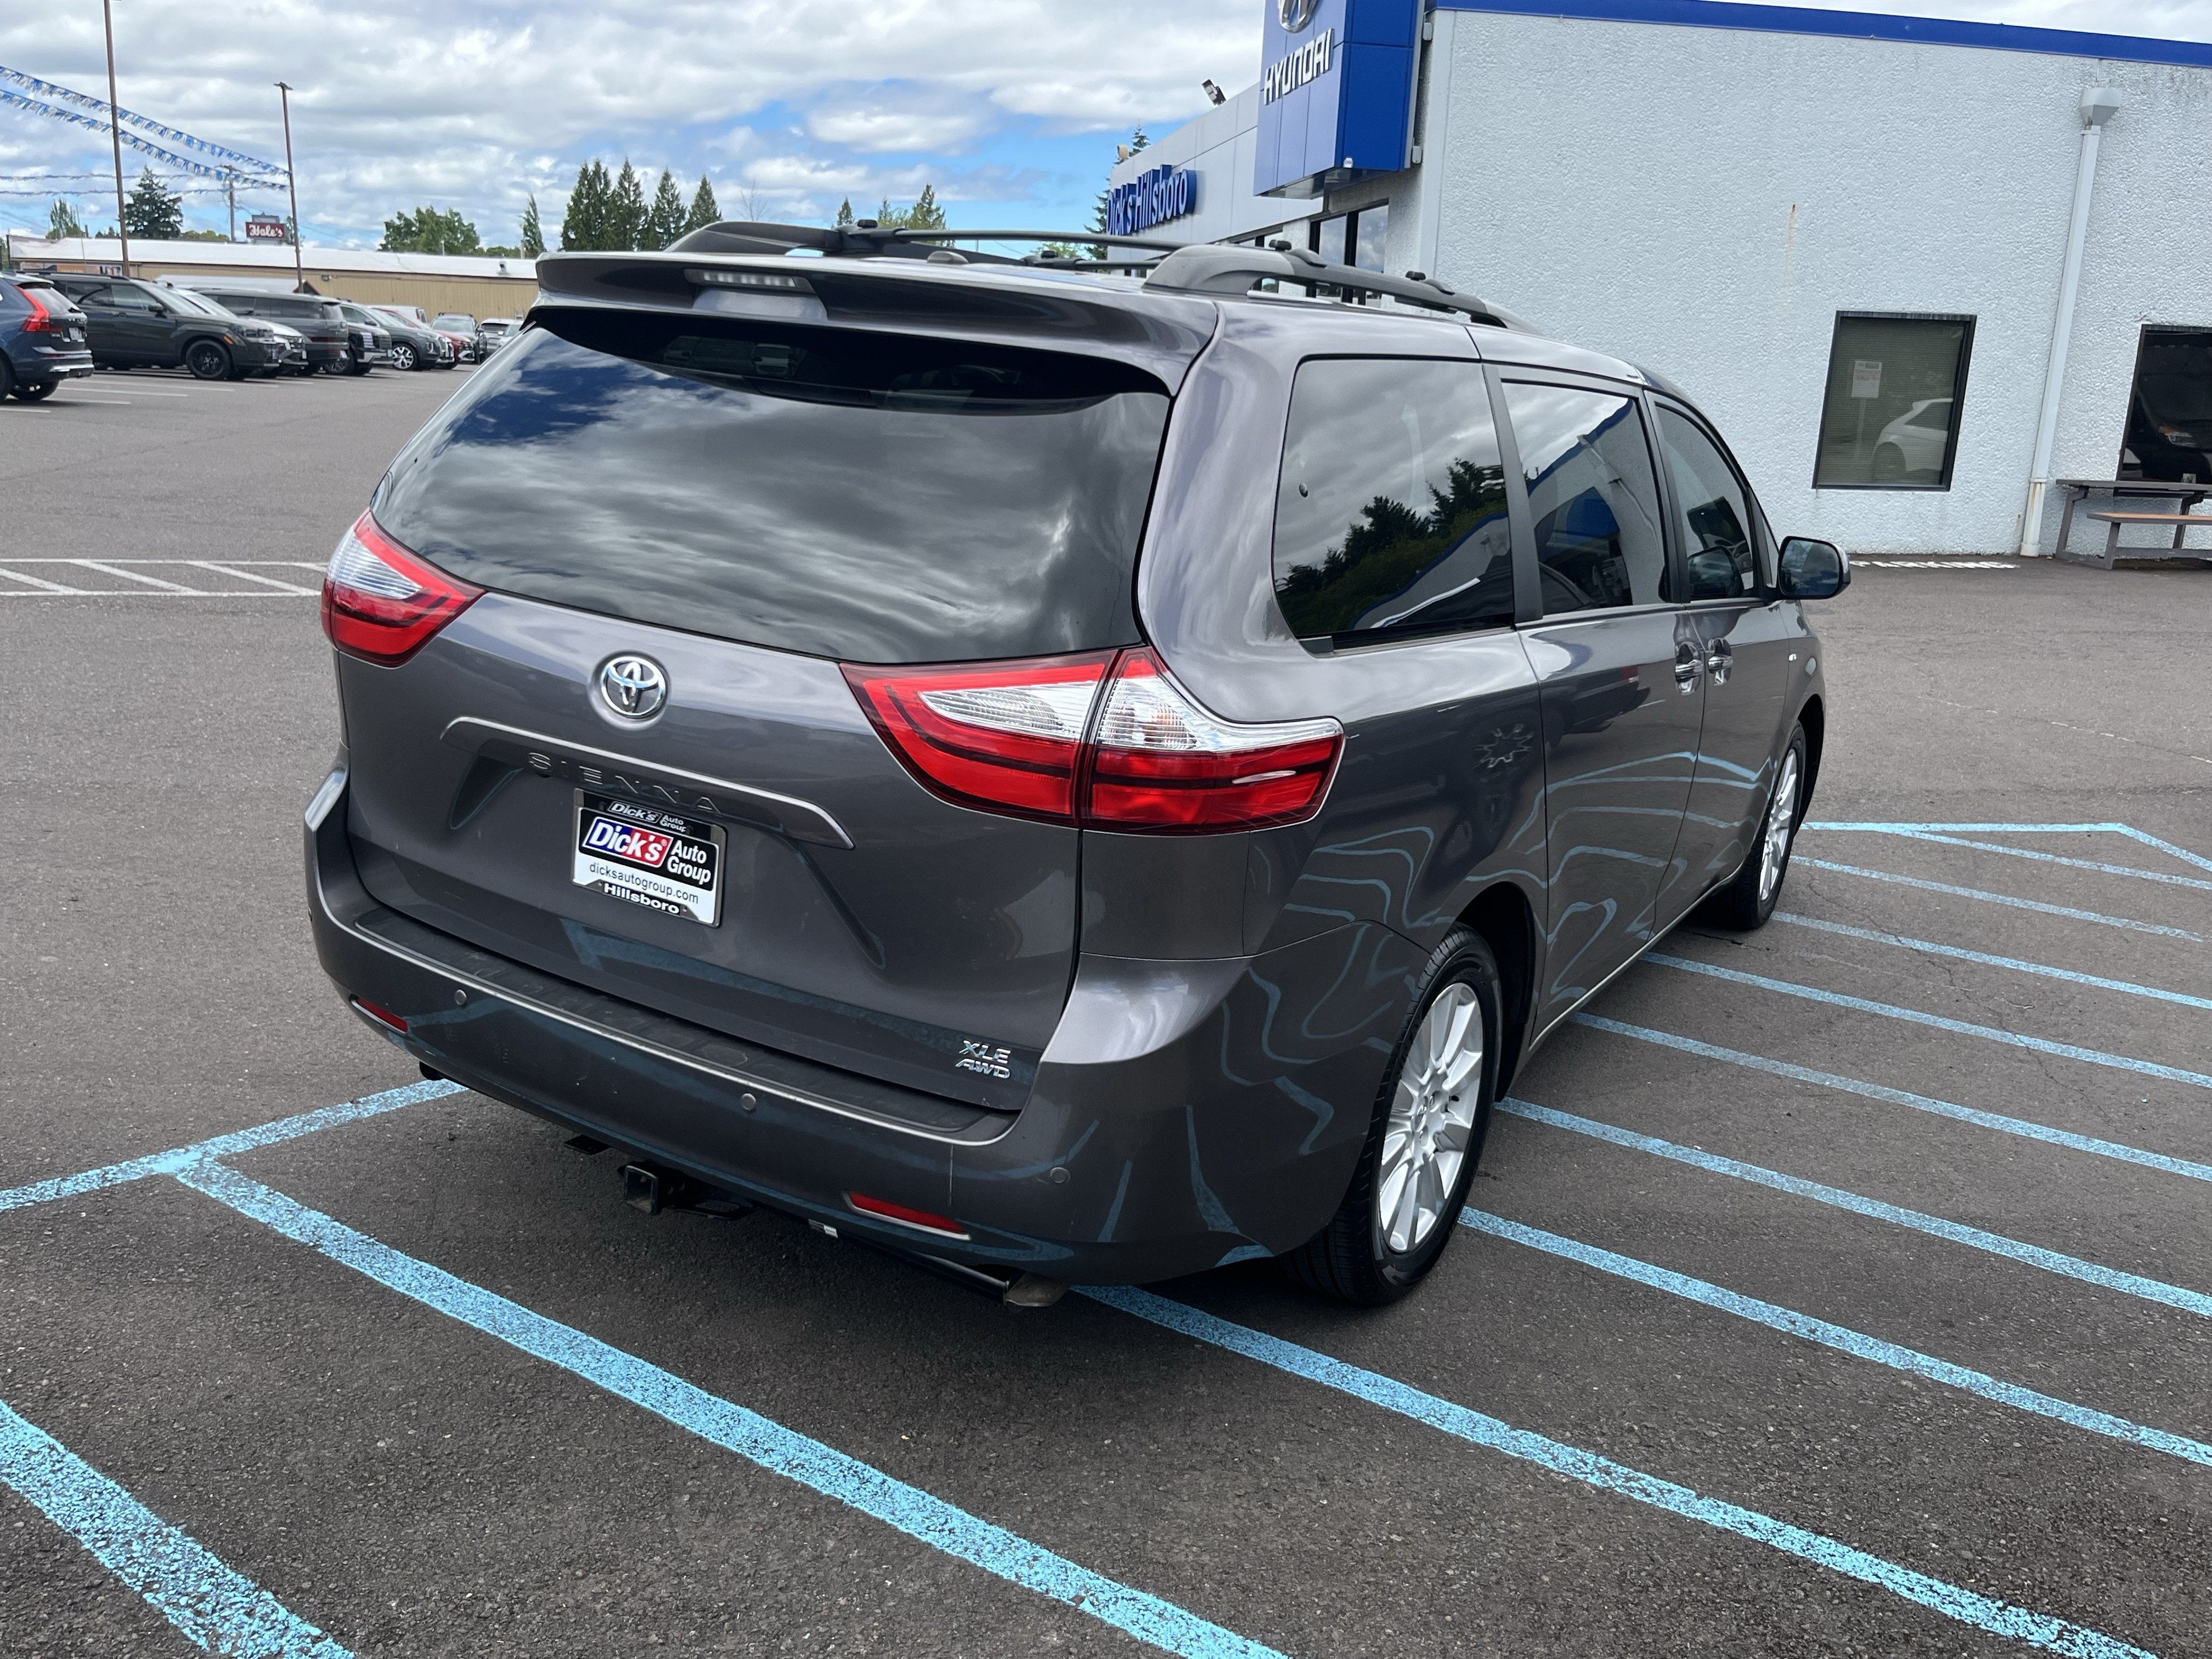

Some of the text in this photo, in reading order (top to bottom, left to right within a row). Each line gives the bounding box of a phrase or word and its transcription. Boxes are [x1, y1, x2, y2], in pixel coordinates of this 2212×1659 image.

[1263, 29, 1332, 105] HYUNDAI
[1134, 164, 1188, 231] Hillsboro
[249, 224, 283, 238] Hale's
[611, 802, 684, 826] Dick's Auto
[659, 820, 687, 833] Group
[589, 822, 707, 864] Dick's Auto
[589, 862, 699, 905] dicksautogroup.com
[667, 856, 712, 885] Group
[603, 882, 680, 915] Hillsboro
[958, 1040, 1011, 1064] XLE
[955, 1058, 1011, 1079] AWD
